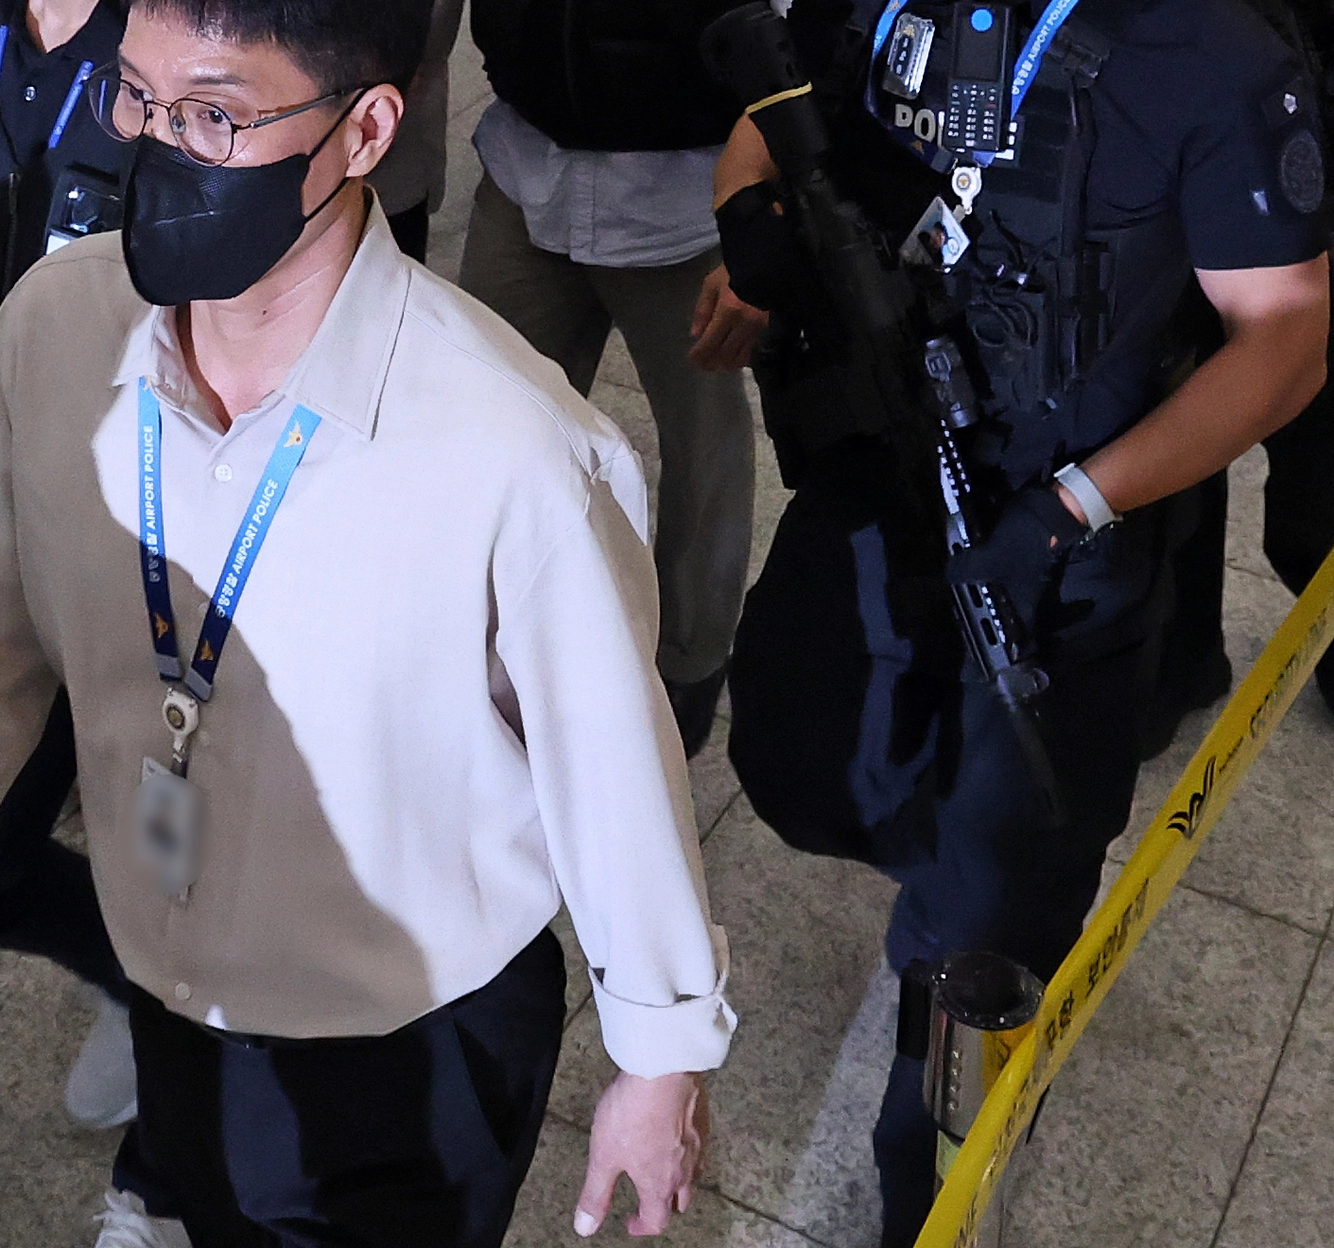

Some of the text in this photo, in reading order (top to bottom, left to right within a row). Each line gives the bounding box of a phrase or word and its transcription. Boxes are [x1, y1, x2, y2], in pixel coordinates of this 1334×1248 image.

[143, 424, 155, 473] POLICE
[143, 476, 156, 531] AIRPORT
[230, 521, 259, 576] AIRPORT
[251, 478, 279, 526] POLICE
